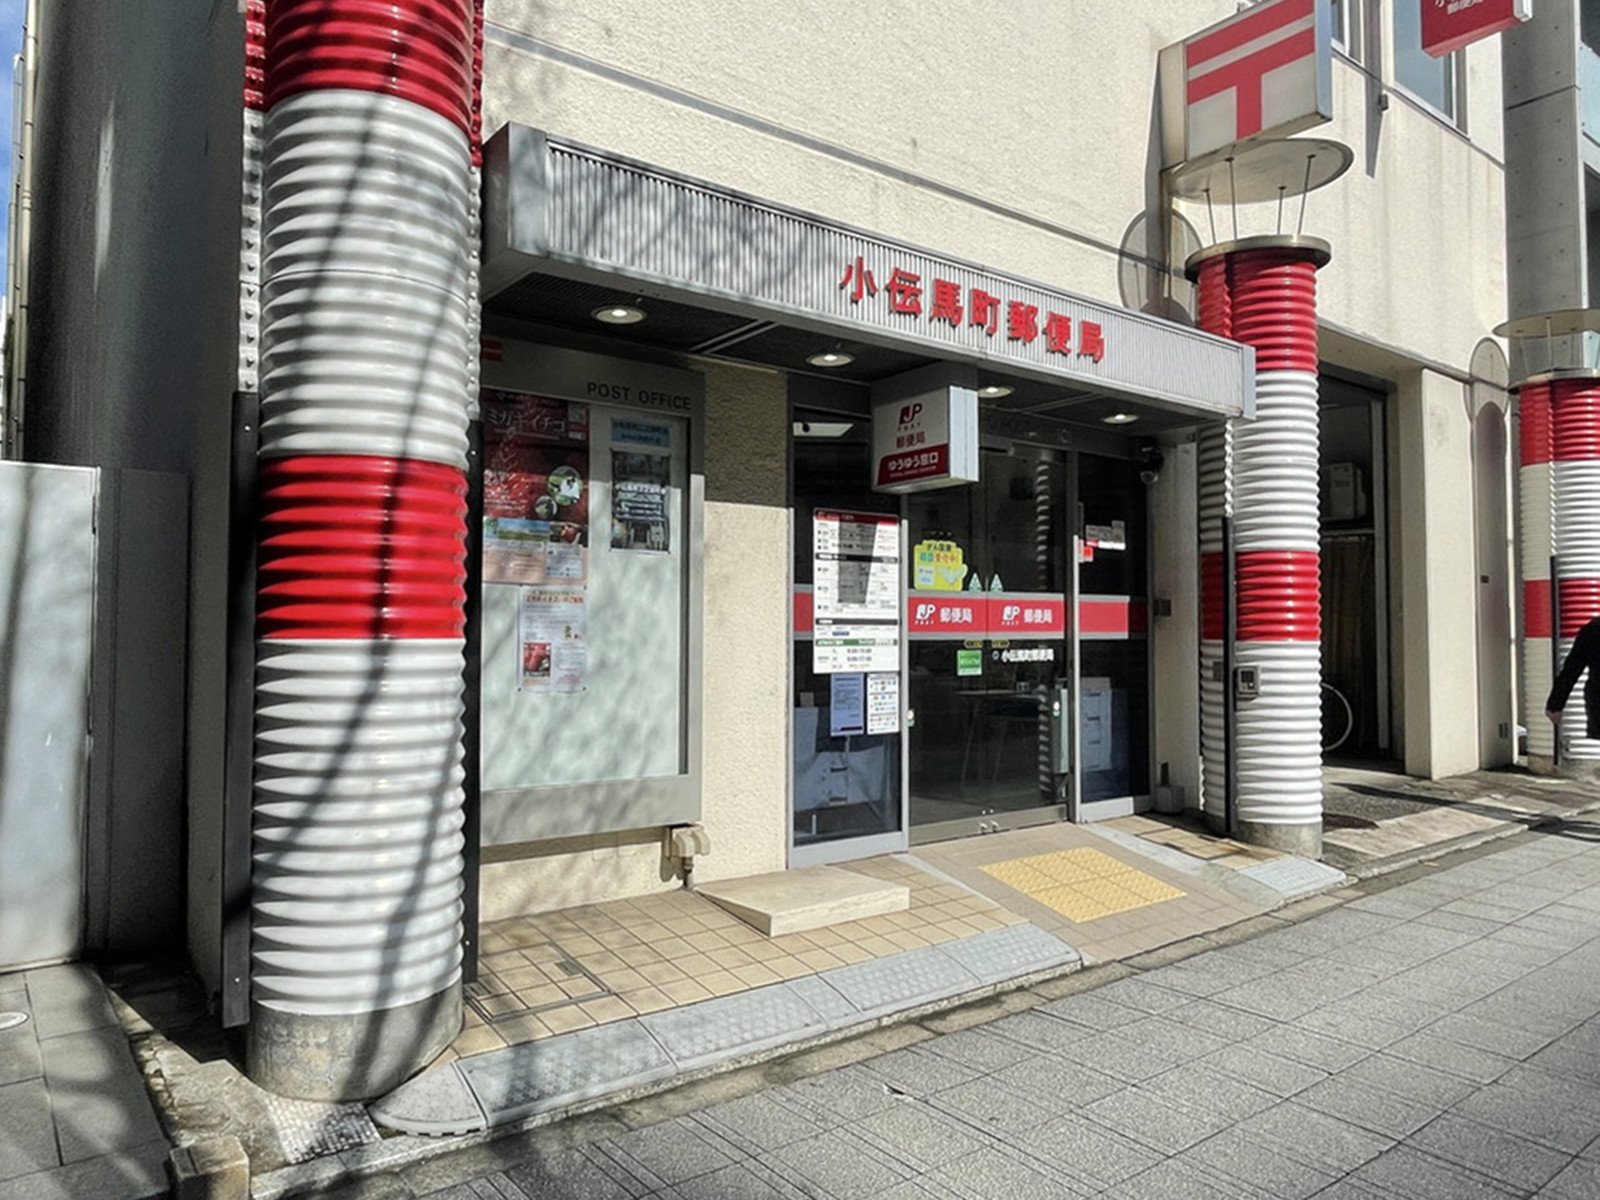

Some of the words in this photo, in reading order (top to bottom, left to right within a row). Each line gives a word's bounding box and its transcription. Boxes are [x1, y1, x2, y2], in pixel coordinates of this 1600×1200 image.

[839, 255, 1105, 364] 小伝馬町郵便局
[587, 382, 631, 400] POST
[638, 390, 693, 411] OFFICE
[895, 430, 926, 449] 郵便局
[887, 451, 940, 471] ゆうゆう窓口
[940, 607, 973, 624] 郵便局
[1023, 608, 1053, 624] 郵便局
